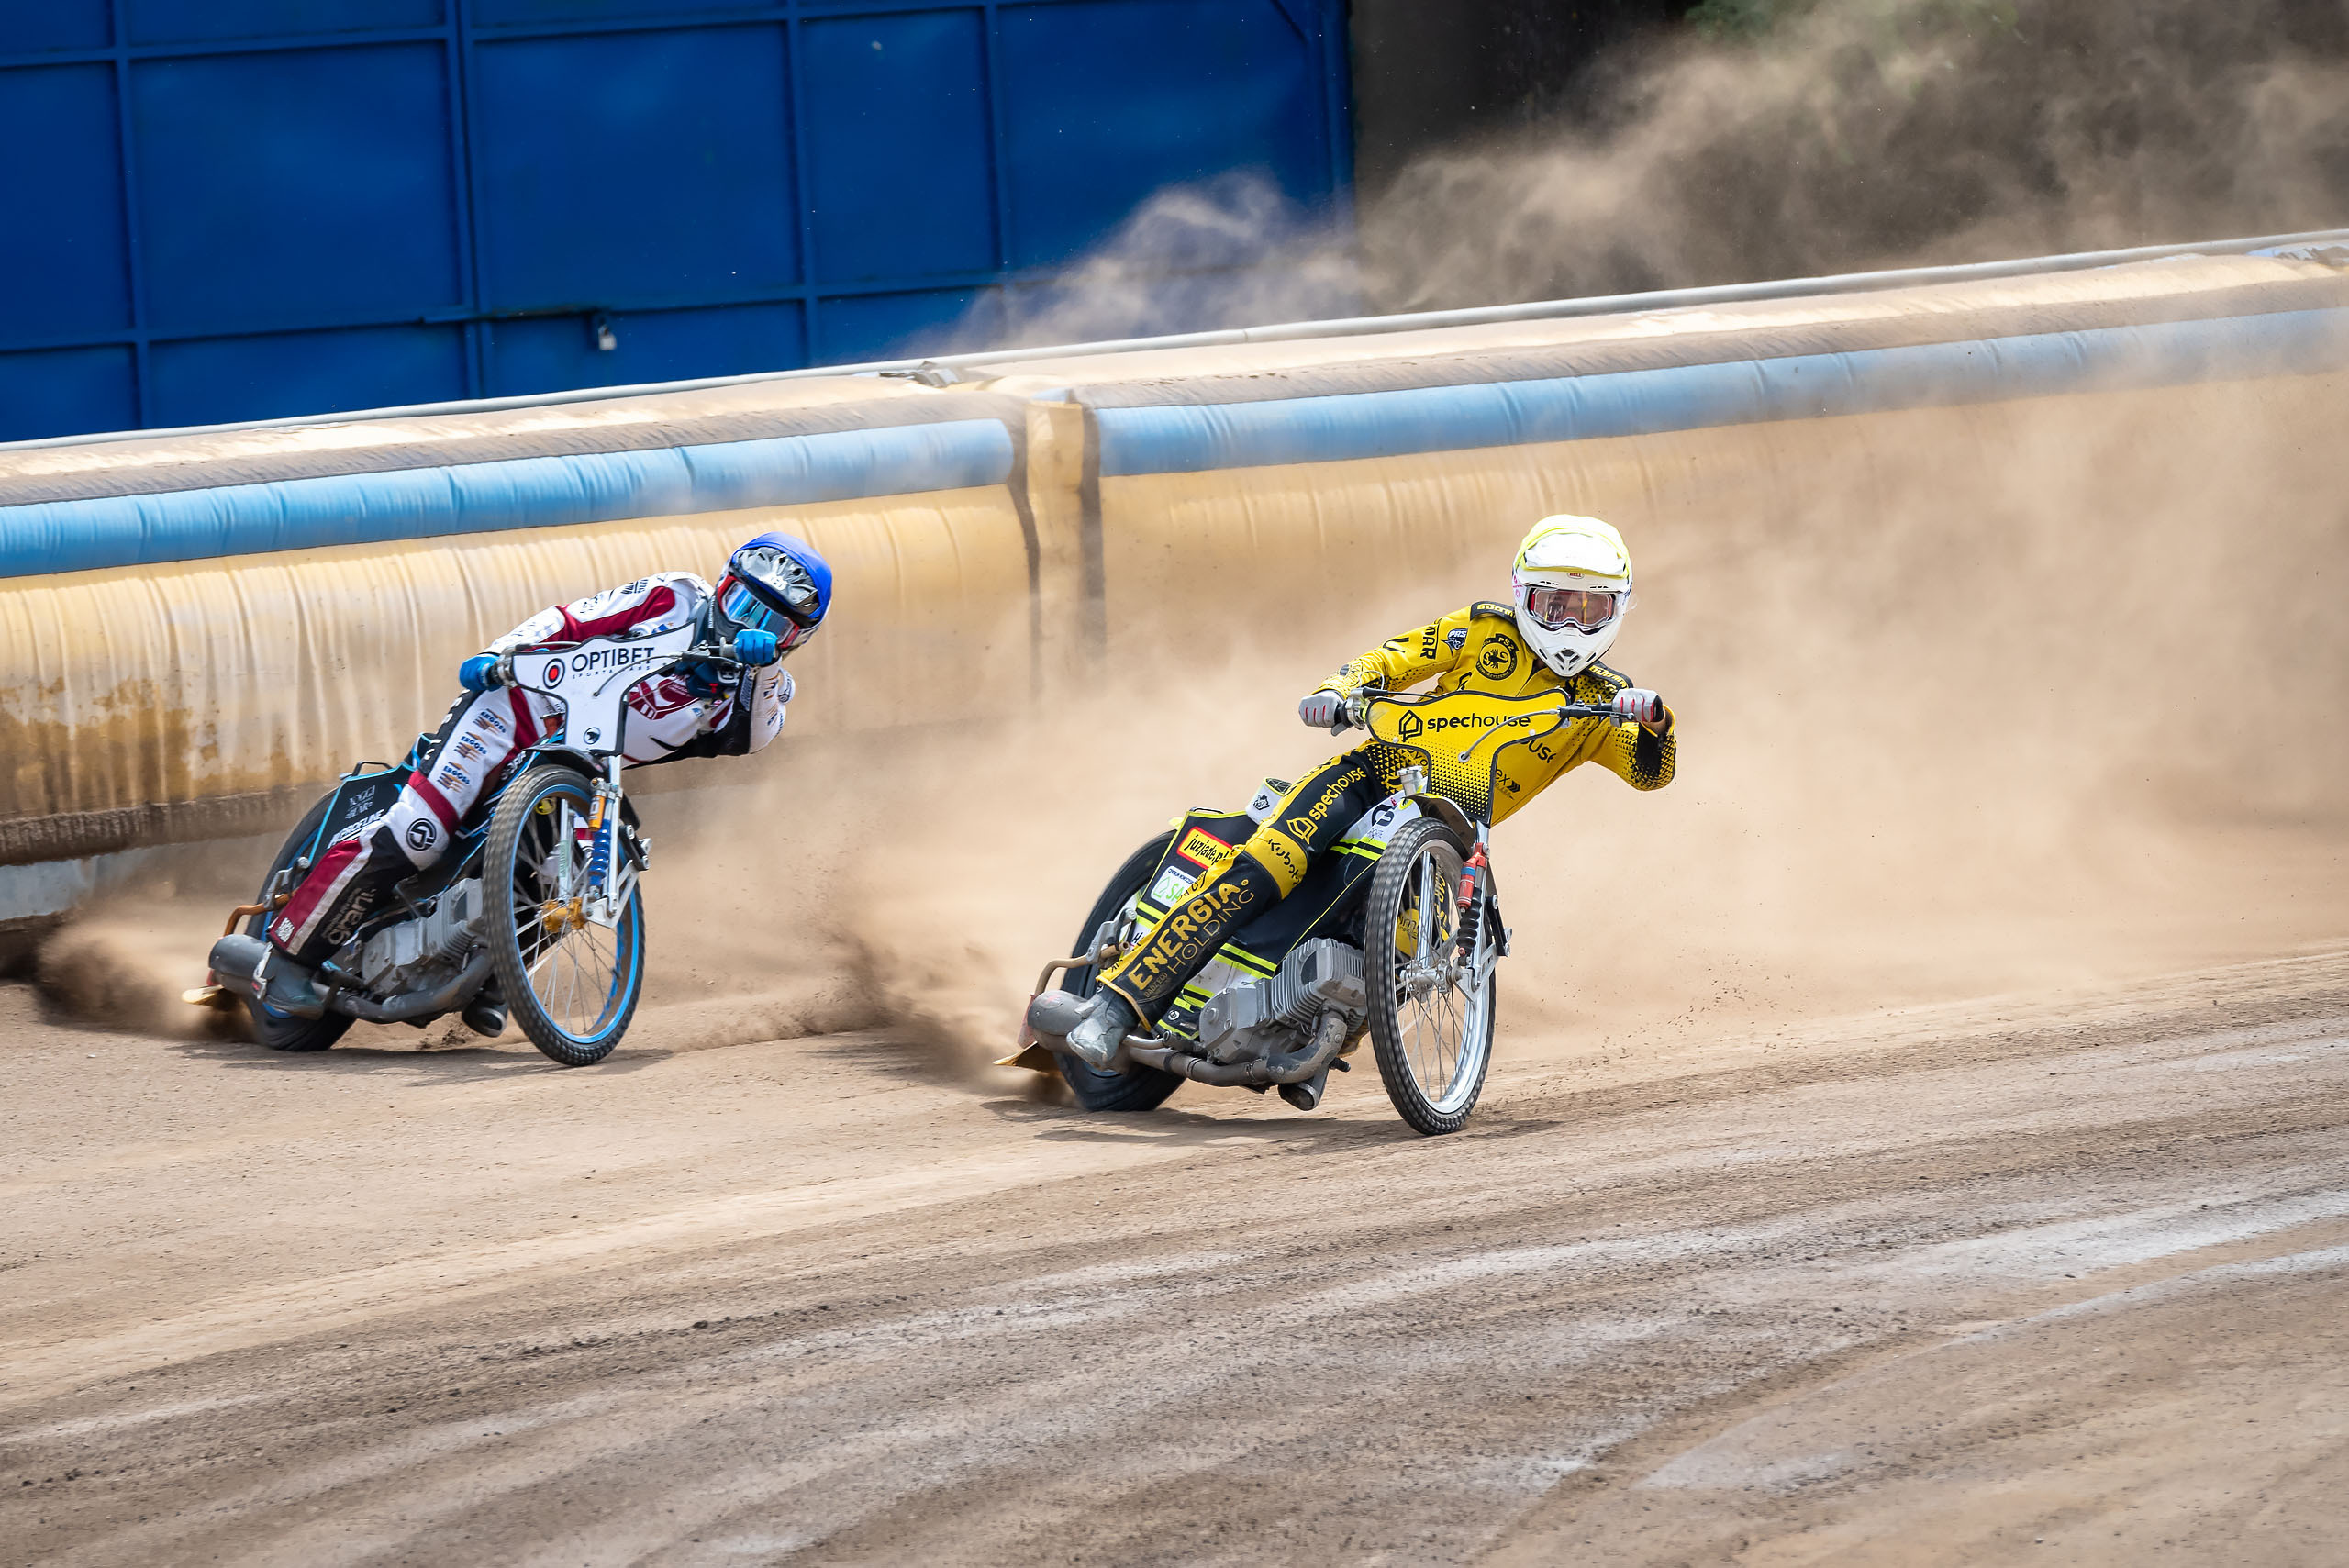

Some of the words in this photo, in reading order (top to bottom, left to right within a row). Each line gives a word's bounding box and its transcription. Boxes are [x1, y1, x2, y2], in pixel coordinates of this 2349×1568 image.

[572, 647, 655, 672] OPTIBET
[1427, 712, 1531, 733] spechouse
[1308, 767, 1367, 821] spechouse
[1128, 882, 1241, 991] ENERGIA
[1167, 888, 1255, 975] HOLDING
